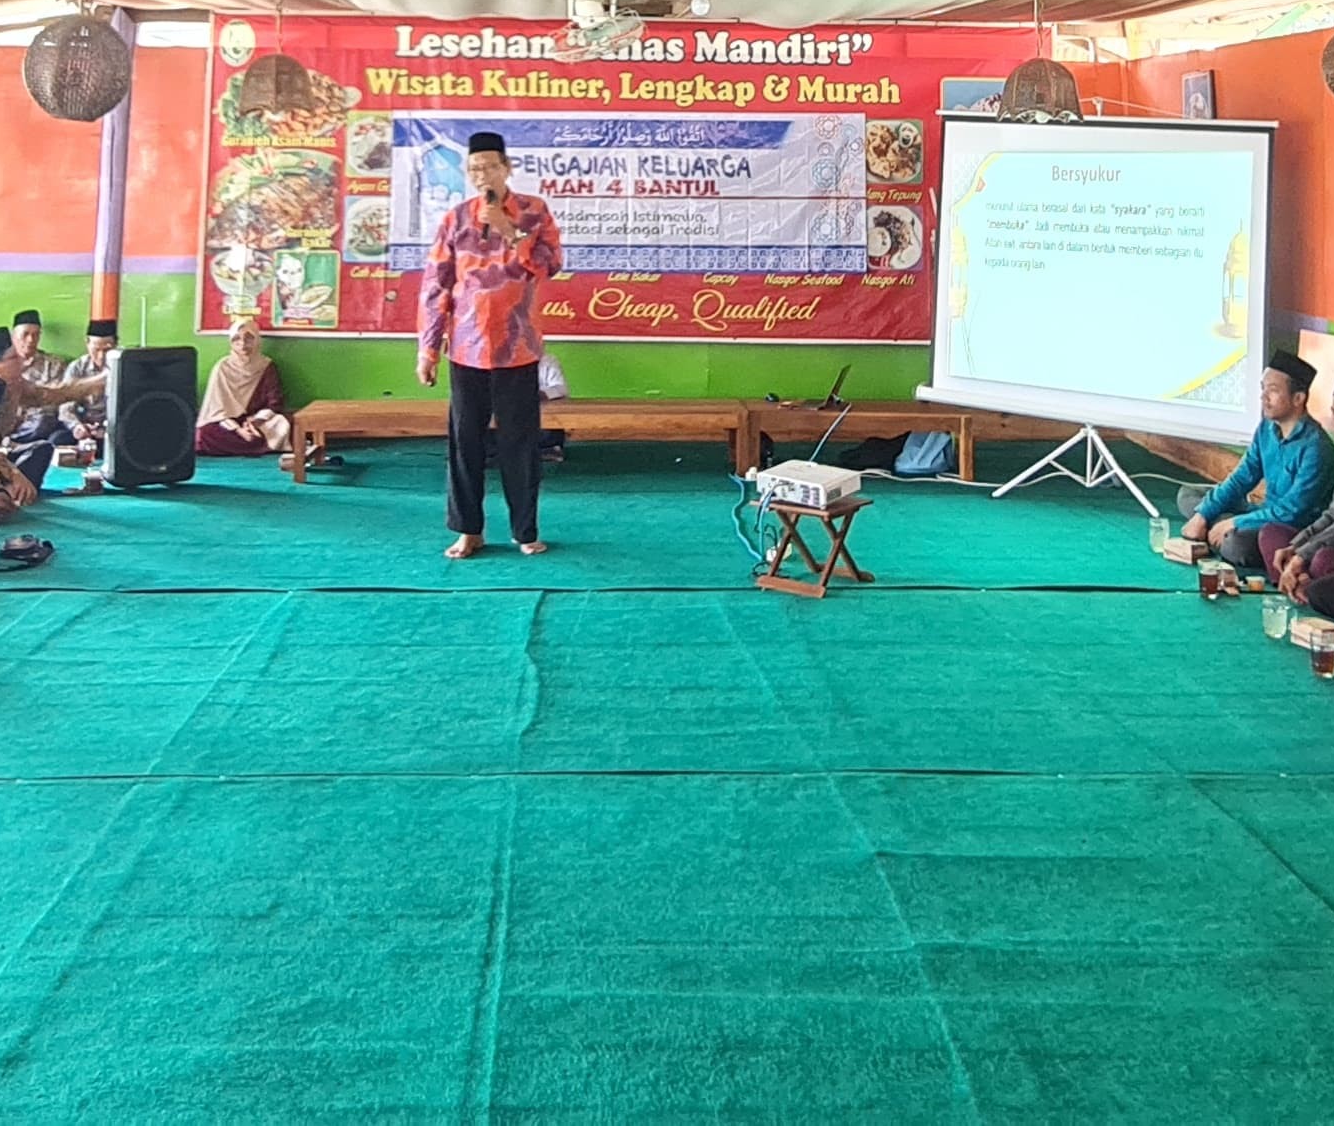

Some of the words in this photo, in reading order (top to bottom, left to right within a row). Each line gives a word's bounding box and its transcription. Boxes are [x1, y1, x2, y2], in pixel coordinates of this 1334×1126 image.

[395, 25, 556, 61] Lesehan
[366, 67, 474, 97] Wisata
[481, 69, 611, 105] Kuliner,
[619, 73, 755, 107] Lengkap
[762, 74, 791, 102] &
[797, 75, 900, 104] Murah
[511, 153, 627, 176] PENGAJIAN
[638, 154, 751, 178] KELUARGA
[1052, 164, 1121, 185] Bersyukur
[605, 179, 623, 194] 4
[634, 179, 720, 196] BANTUL
[606, 224, 664, 238] sebagai
[588, 288, 678, 322] Cheap,
[691, 289, 821, 331] Qualified
